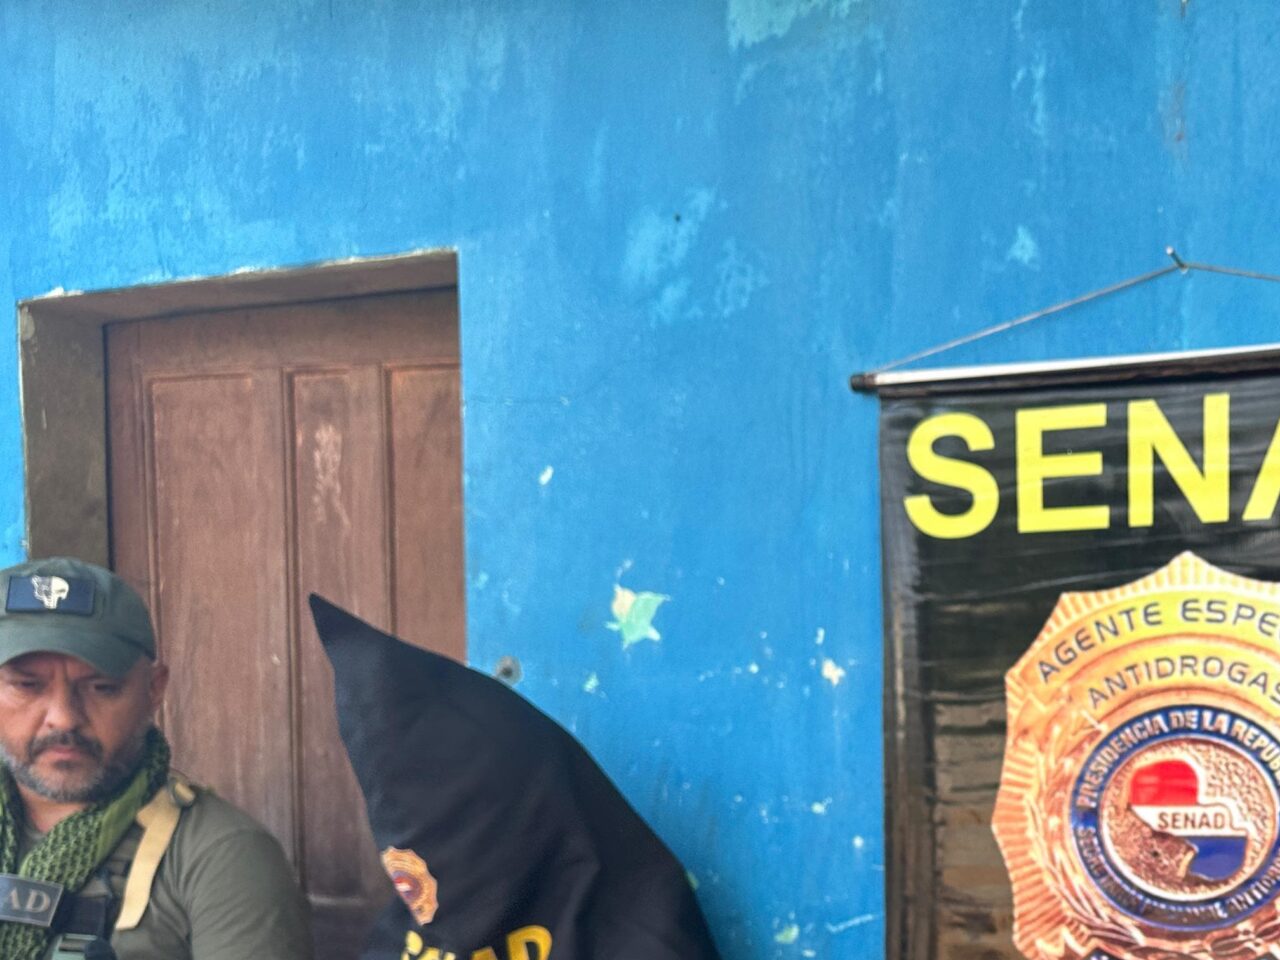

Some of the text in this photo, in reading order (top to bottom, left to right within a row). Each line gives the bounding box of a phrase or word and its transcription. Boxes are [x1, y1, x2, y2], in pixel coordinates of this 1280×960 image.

[1037, 602, 1162, 683] AGENTE
[1076, 715, 1168, 809] PRESIDENCIA
[1169, 710, 1199, 730] DE
[1202, 710, 1230, 732] LA
[1158, 811, 1226, 830] SENAD
